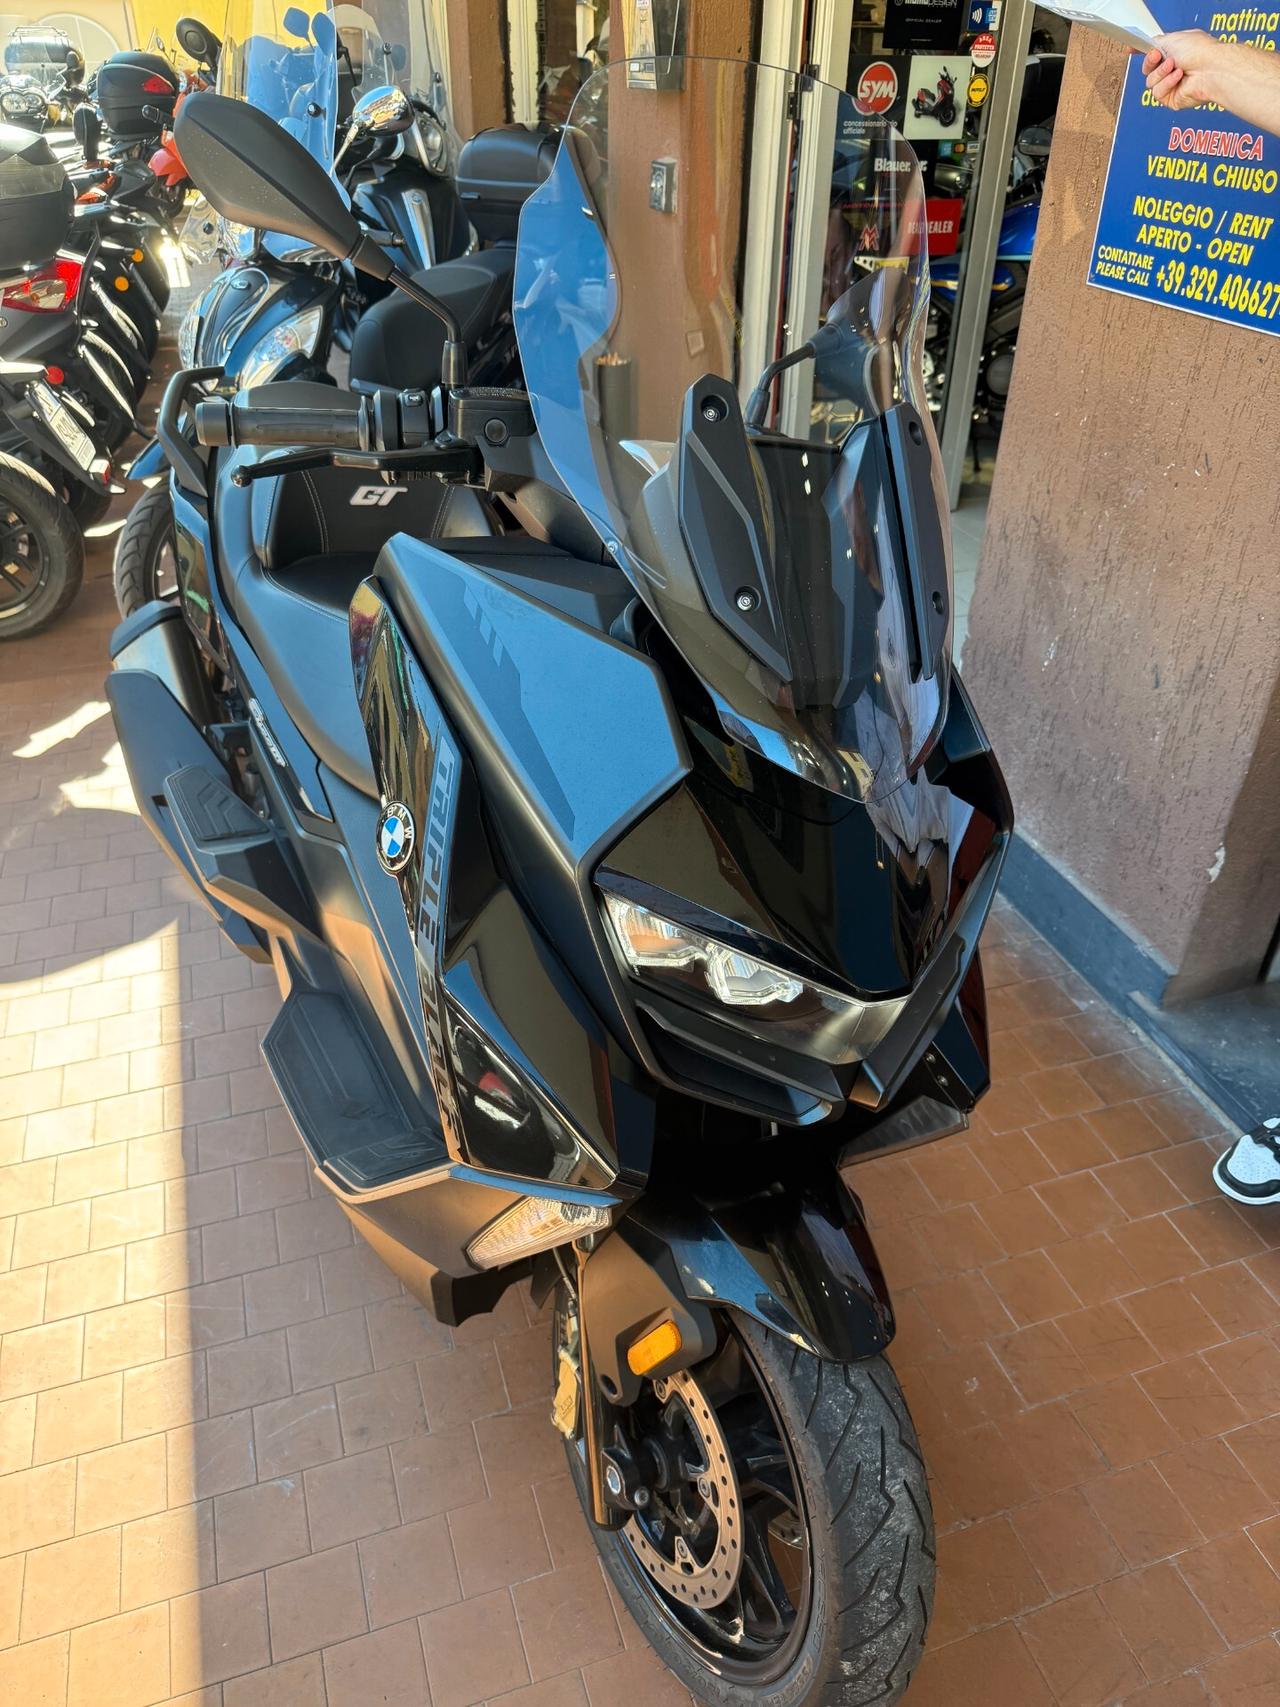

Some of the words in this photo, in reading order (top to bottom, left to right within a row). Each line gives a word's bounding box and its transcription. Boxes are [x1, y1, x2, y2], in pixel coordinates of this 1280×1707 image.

[1210, 8, 1280, 32] mattina
[860, 81, 898, 103] SYM
[1168, 127, 1263, 161] DOMENICA
[1147, 155, 1208, 184] VENDITA
[1213, 163, 1278, 193] CHIUSO
[1133, 195, 1214, 229] NOLEGGIO
[1215, 210, 1228, 234] /
[1229, 212, 1275, 240] RENT
[1098, 245, 1154, 270] CONTATTARE
[1136, 224, 1192, 253] APERTO
[1207, 238, 1255, 267] OPEN
[1096, 261, 1127, 281] PLEASE
[1127, 269, 1150, 287] CALL
[1156, 259, 1280, 319] +39.329.406627
[349, 486, 409, 506] GT
[387, 805, 413, 839] BMW
[420, 761, 454, 947] TRIPLE
